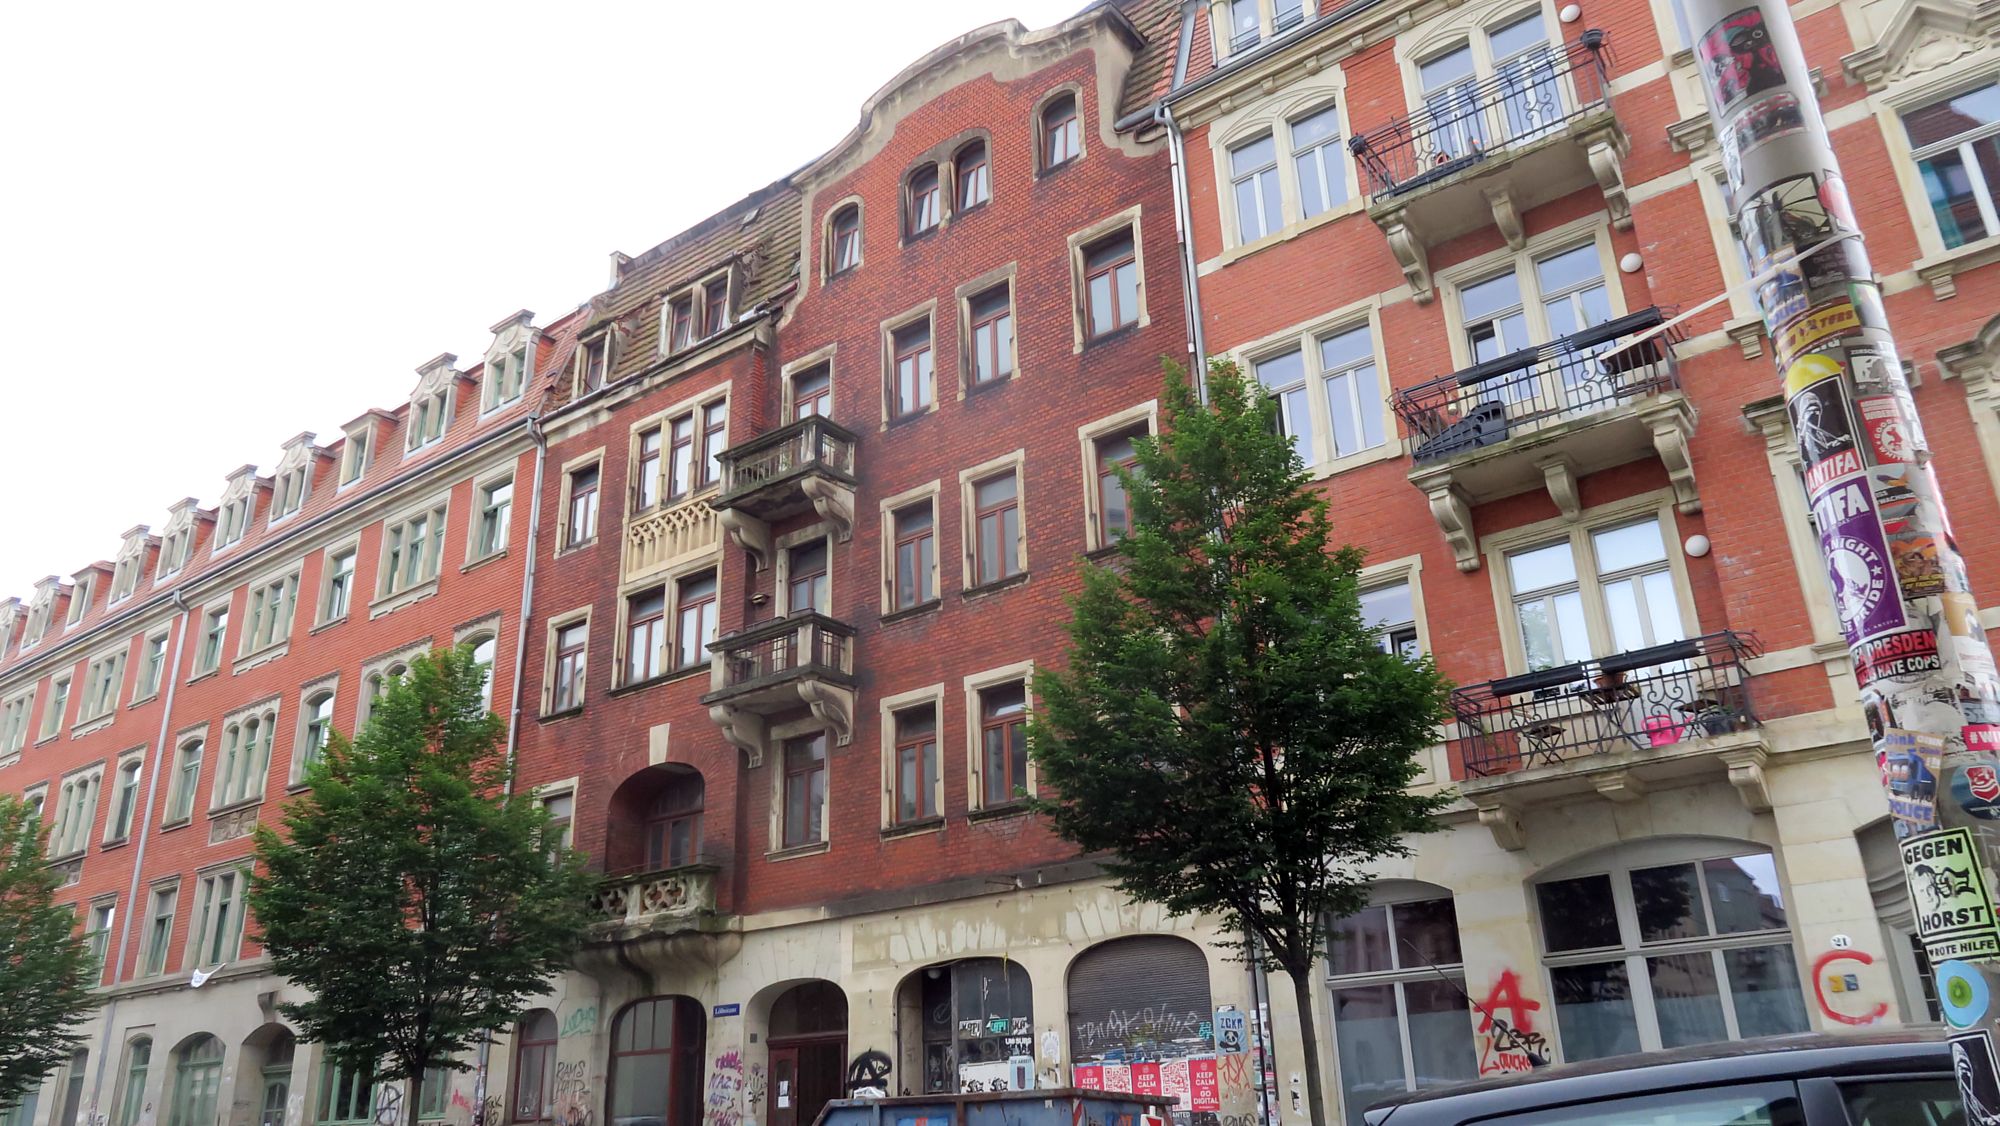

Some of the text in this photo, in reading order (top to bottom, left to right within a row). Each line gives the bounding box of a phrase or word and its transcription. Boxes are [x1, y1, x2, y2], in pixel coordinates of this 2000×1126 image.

[1807, 451, 1858, 491] ANTIFA
[1830, 537, 1879, 562] NIGHT
[1866, 630, 1936, 660] DRESDEN
[1877, 660, 1905, 679] HATE
[1907, 654, 1940, 671] COPS
[1904, 837, 1964, 865] GEGEN
[1921, 905, 1985, 932] HORST
[1960, 940, 1995, 953] HILFE
[1193, 1097, 1219, 1105] DIGITAL
